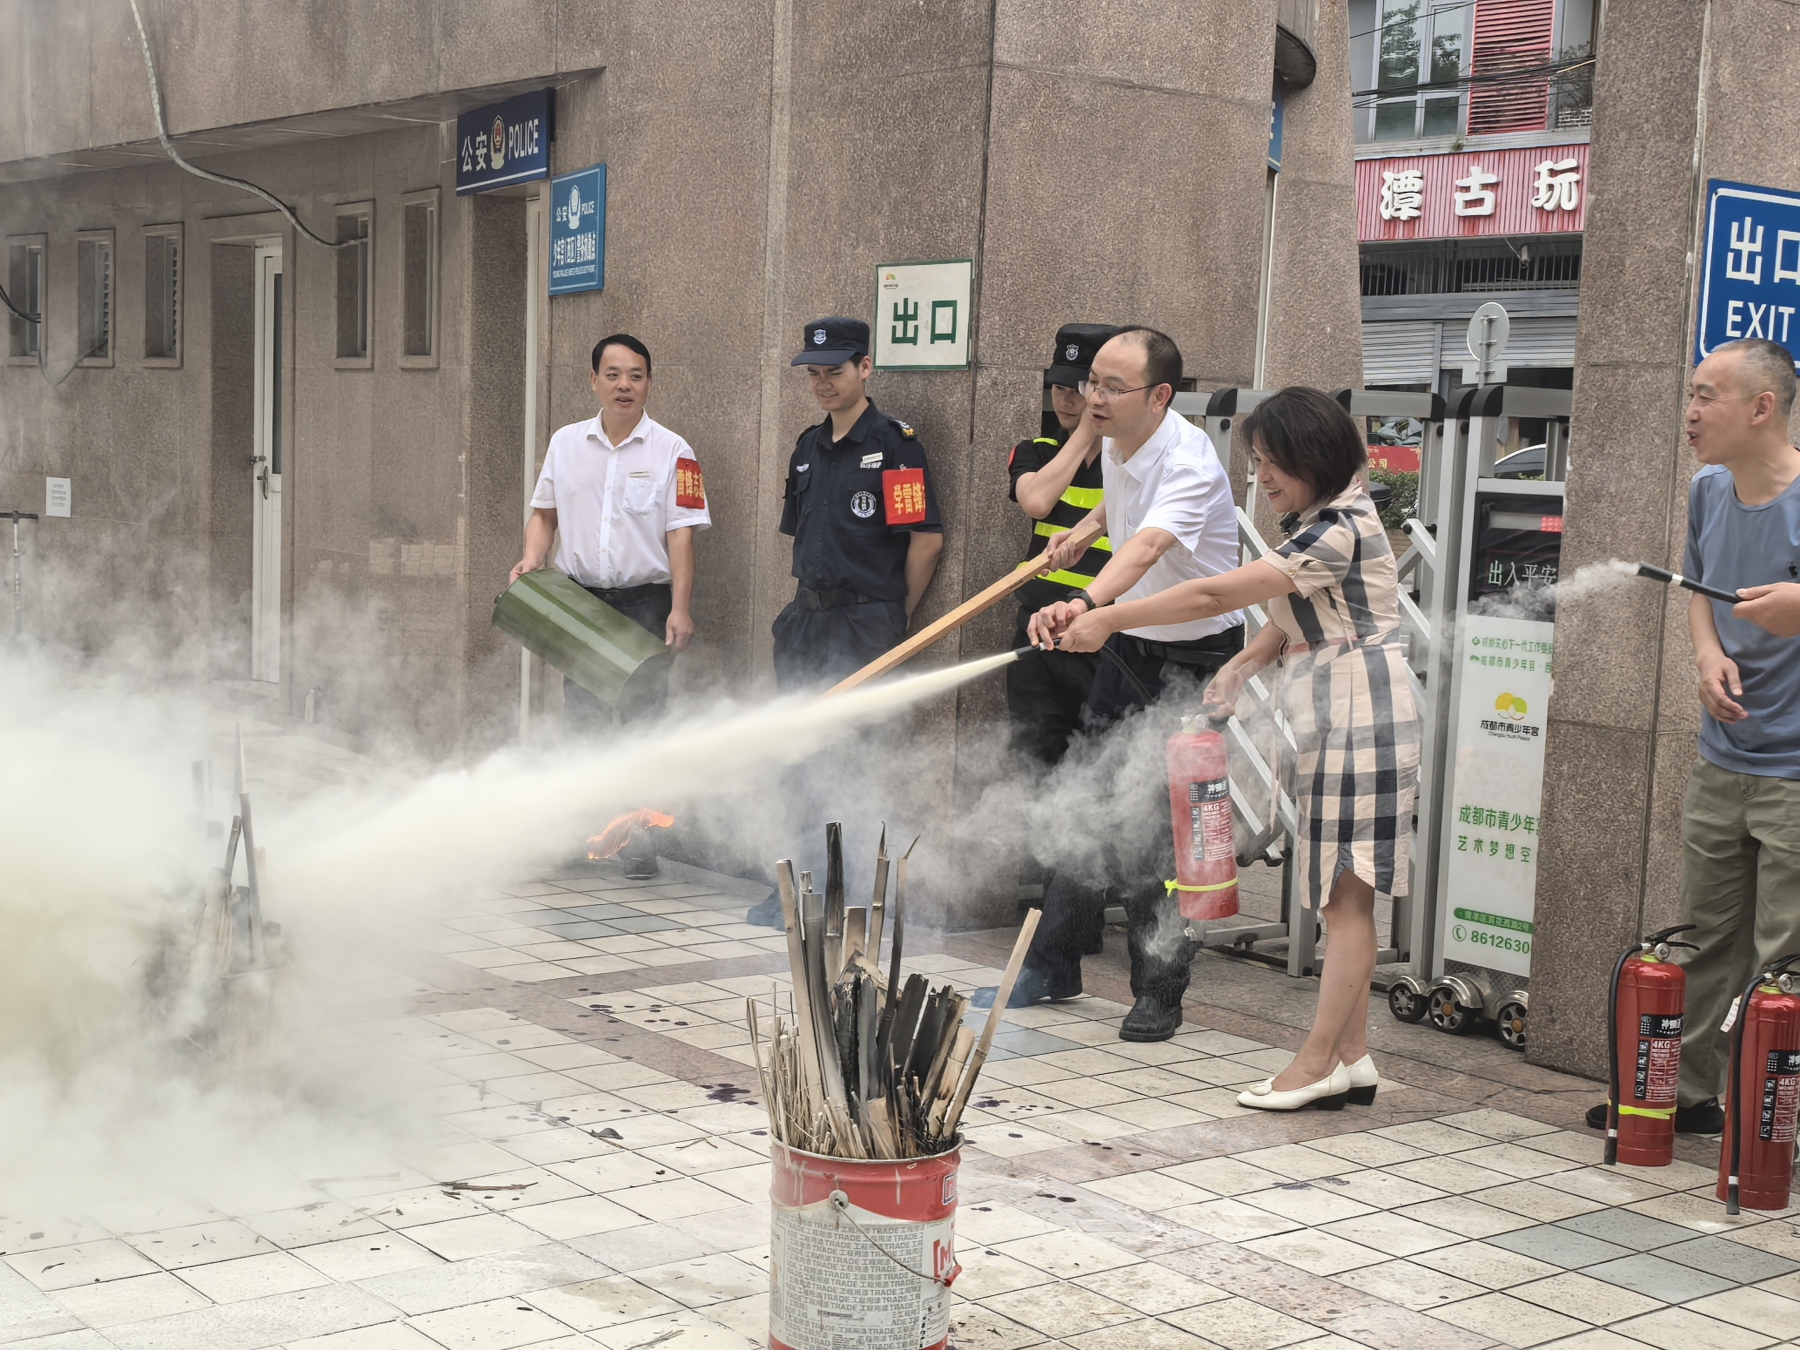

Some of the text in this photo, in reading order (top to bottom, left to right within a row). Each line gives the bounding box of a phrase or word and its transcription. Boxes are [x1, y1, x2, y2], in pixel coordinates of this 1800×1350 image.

[461, 118, 539, 173] 公安 POLICE
[1380, 158, 1581, 221] 潭古玩
[581, 201, 595, 215] POLICE
[1725, 216, 1800, 286] 出口
[891, 297, 957, 346] 出口
[1725, 299, 1796, 343] EXIT
[893, 482, 926, 515] 学雷锋
[1488, 560, 1557, 590] 出入平安
[1480, 719, 1540, 737] 成都市青少年宫
[1202, 803, 1220, 812] 4KG
[1471, 930, 1530, 954] 8612630
[1652, 1040, 1671, 1049] 4KG
[1778, 1077, 1796, 1086] 4KG
